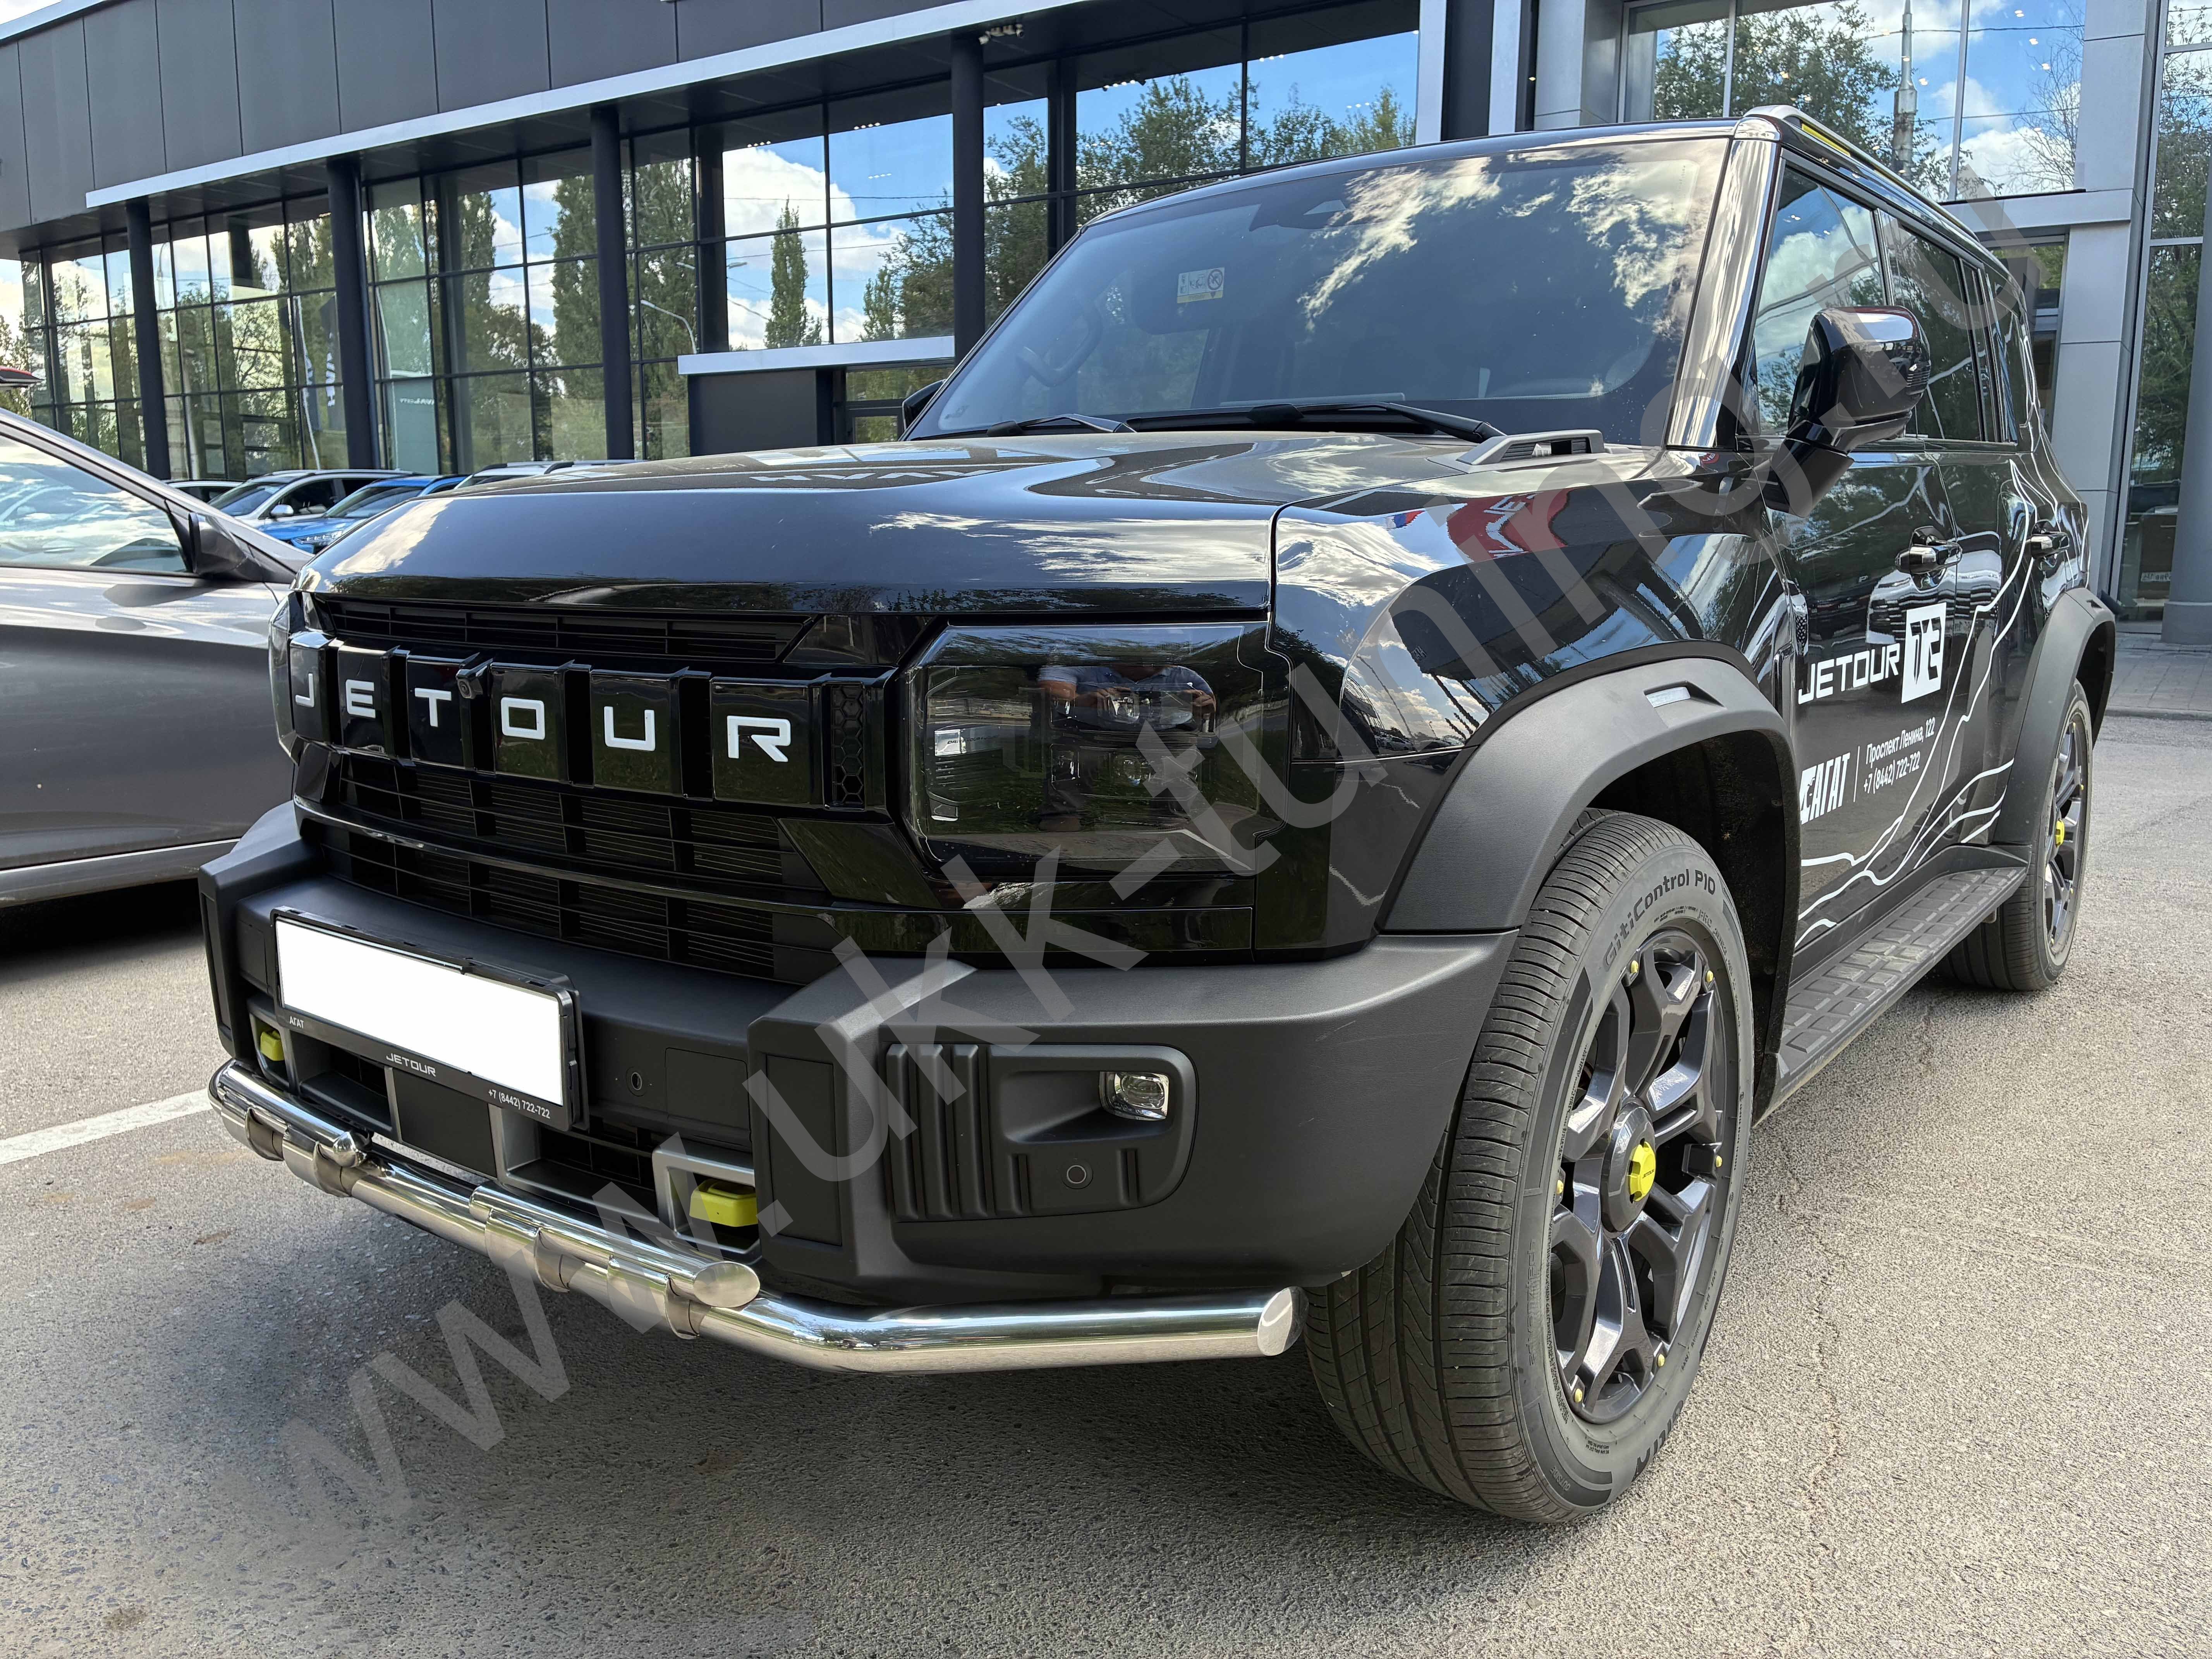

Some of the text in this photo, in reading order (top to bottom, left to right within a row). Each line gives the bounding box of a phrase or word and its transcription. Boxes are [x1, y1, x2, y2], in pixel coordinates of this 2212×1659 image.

[1798, 643, 1900, 705] JETOUR
[295, 673, 791, 763] JETOUR
[1866, 717, 1935, 769] Проспект Ленина, 122
[1809, 752, 1850, 821] АГАТ
[1864, 751, 1920, 794] +7 (8442) 722-722
[1602, 869, 1690, 967] GitiControl
[1695, 869, 1716, 895] P10
[290, 1016, 304, 1029] АГАТ
[386, 1053, 436, 1077] JETOUR
[488, 1089, 550, 1119] +7 (8442) 722-722
[1550, 1465, 1571, 1492] OUTSIDE
